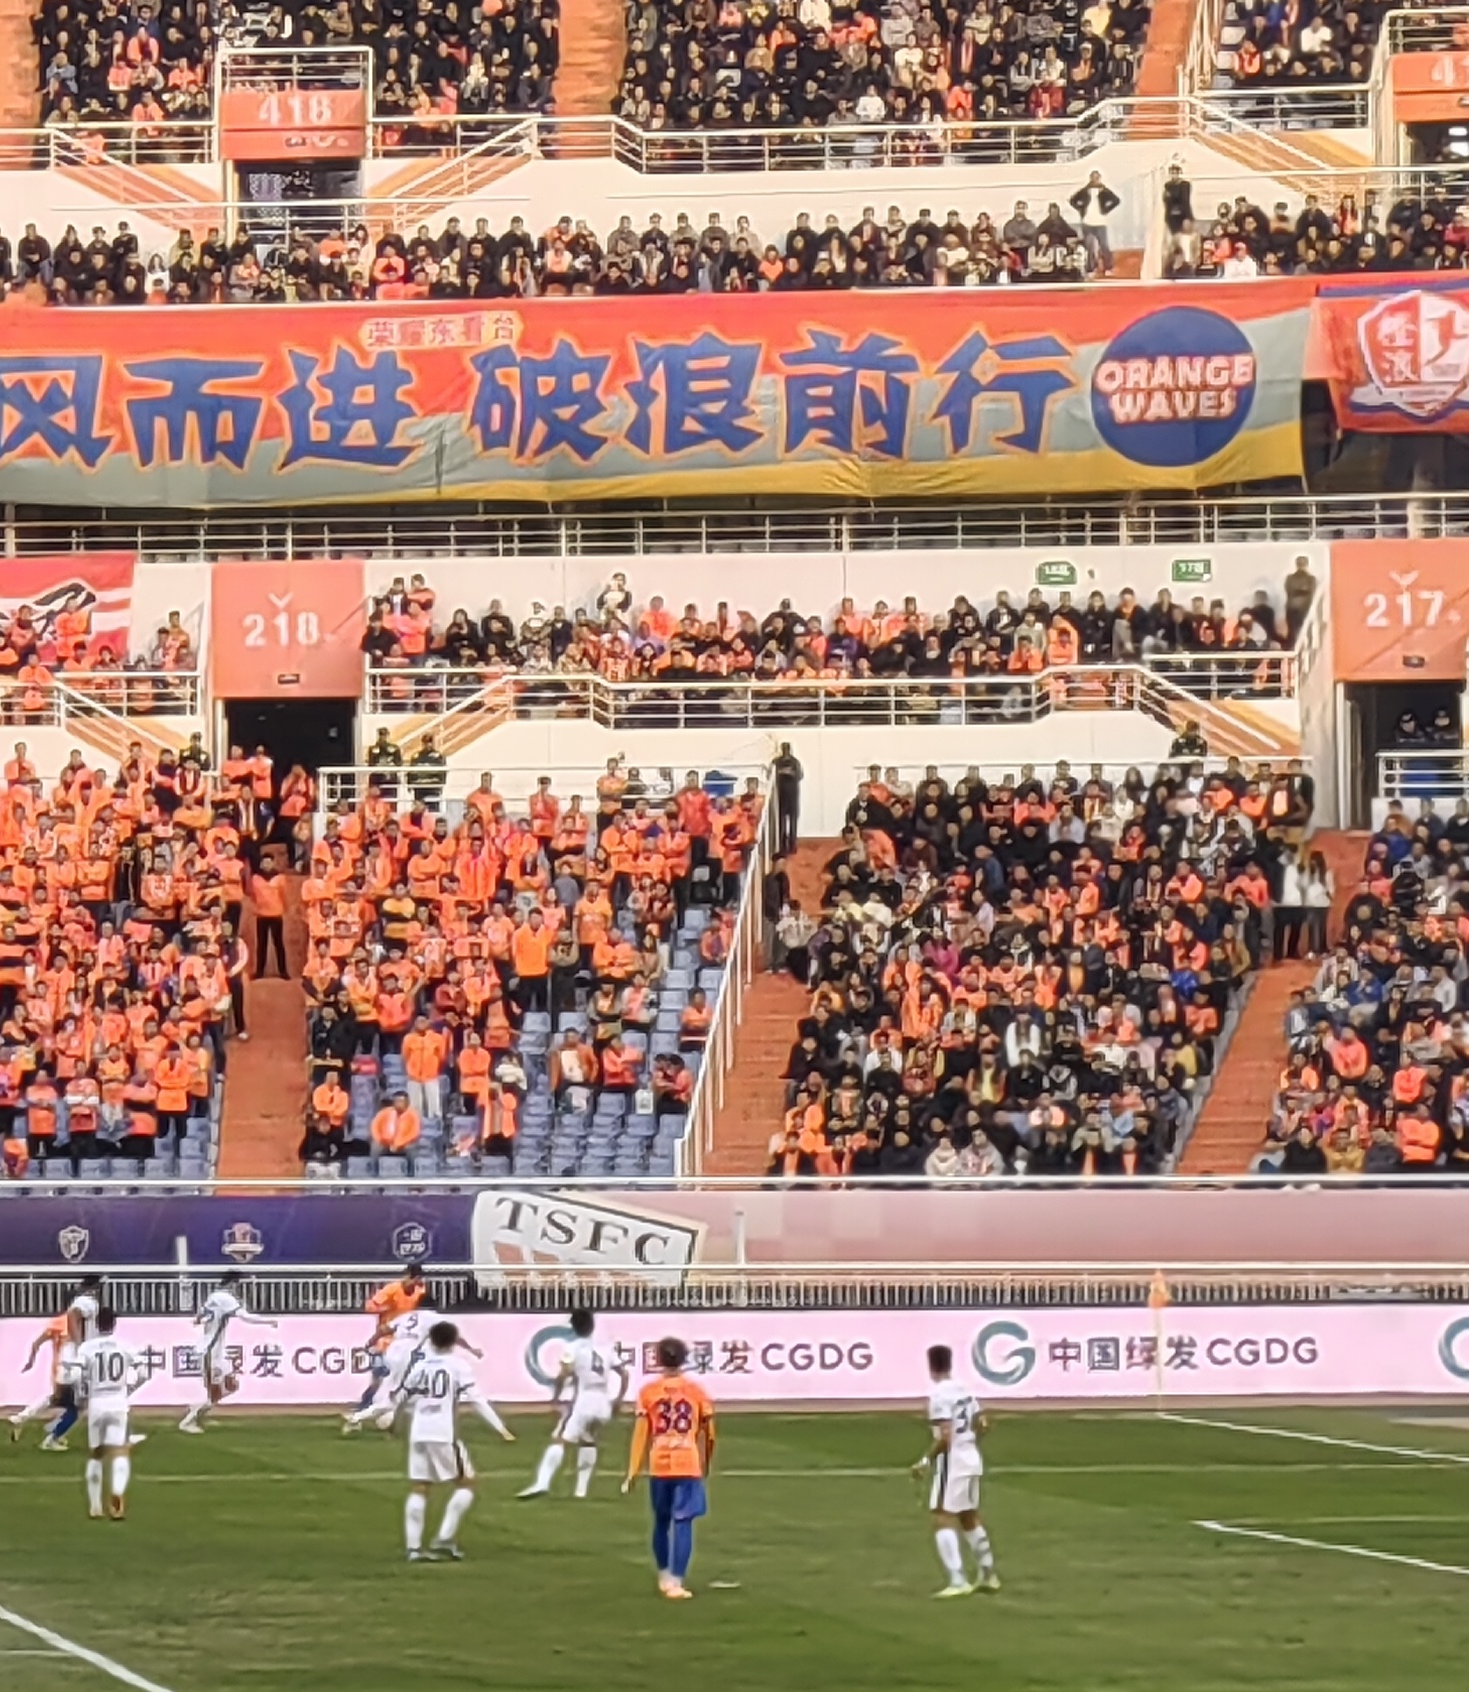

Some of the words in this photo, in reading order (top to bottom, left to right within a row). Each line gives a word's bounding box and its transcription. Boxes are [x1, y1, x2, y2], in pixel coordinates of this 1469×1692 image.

[1096, 354, 1254, 392] ORANGE
[468, 330, 1074, 462] 破浪前行
[1109, 387, 1237, 424] WAVES
[1364, 590, 1444, 628] 217
[494, 1198, 671, 1264] TSFC
[95, 1352, 124, 1382] 10
[760, 1342, 874, 1371] CGDG
[1048, 1336, 1198, 1372] 中国绿发
[1206, 1337, 1319, 1365] CGDG
[654, 1398, 692, 1434] 38
